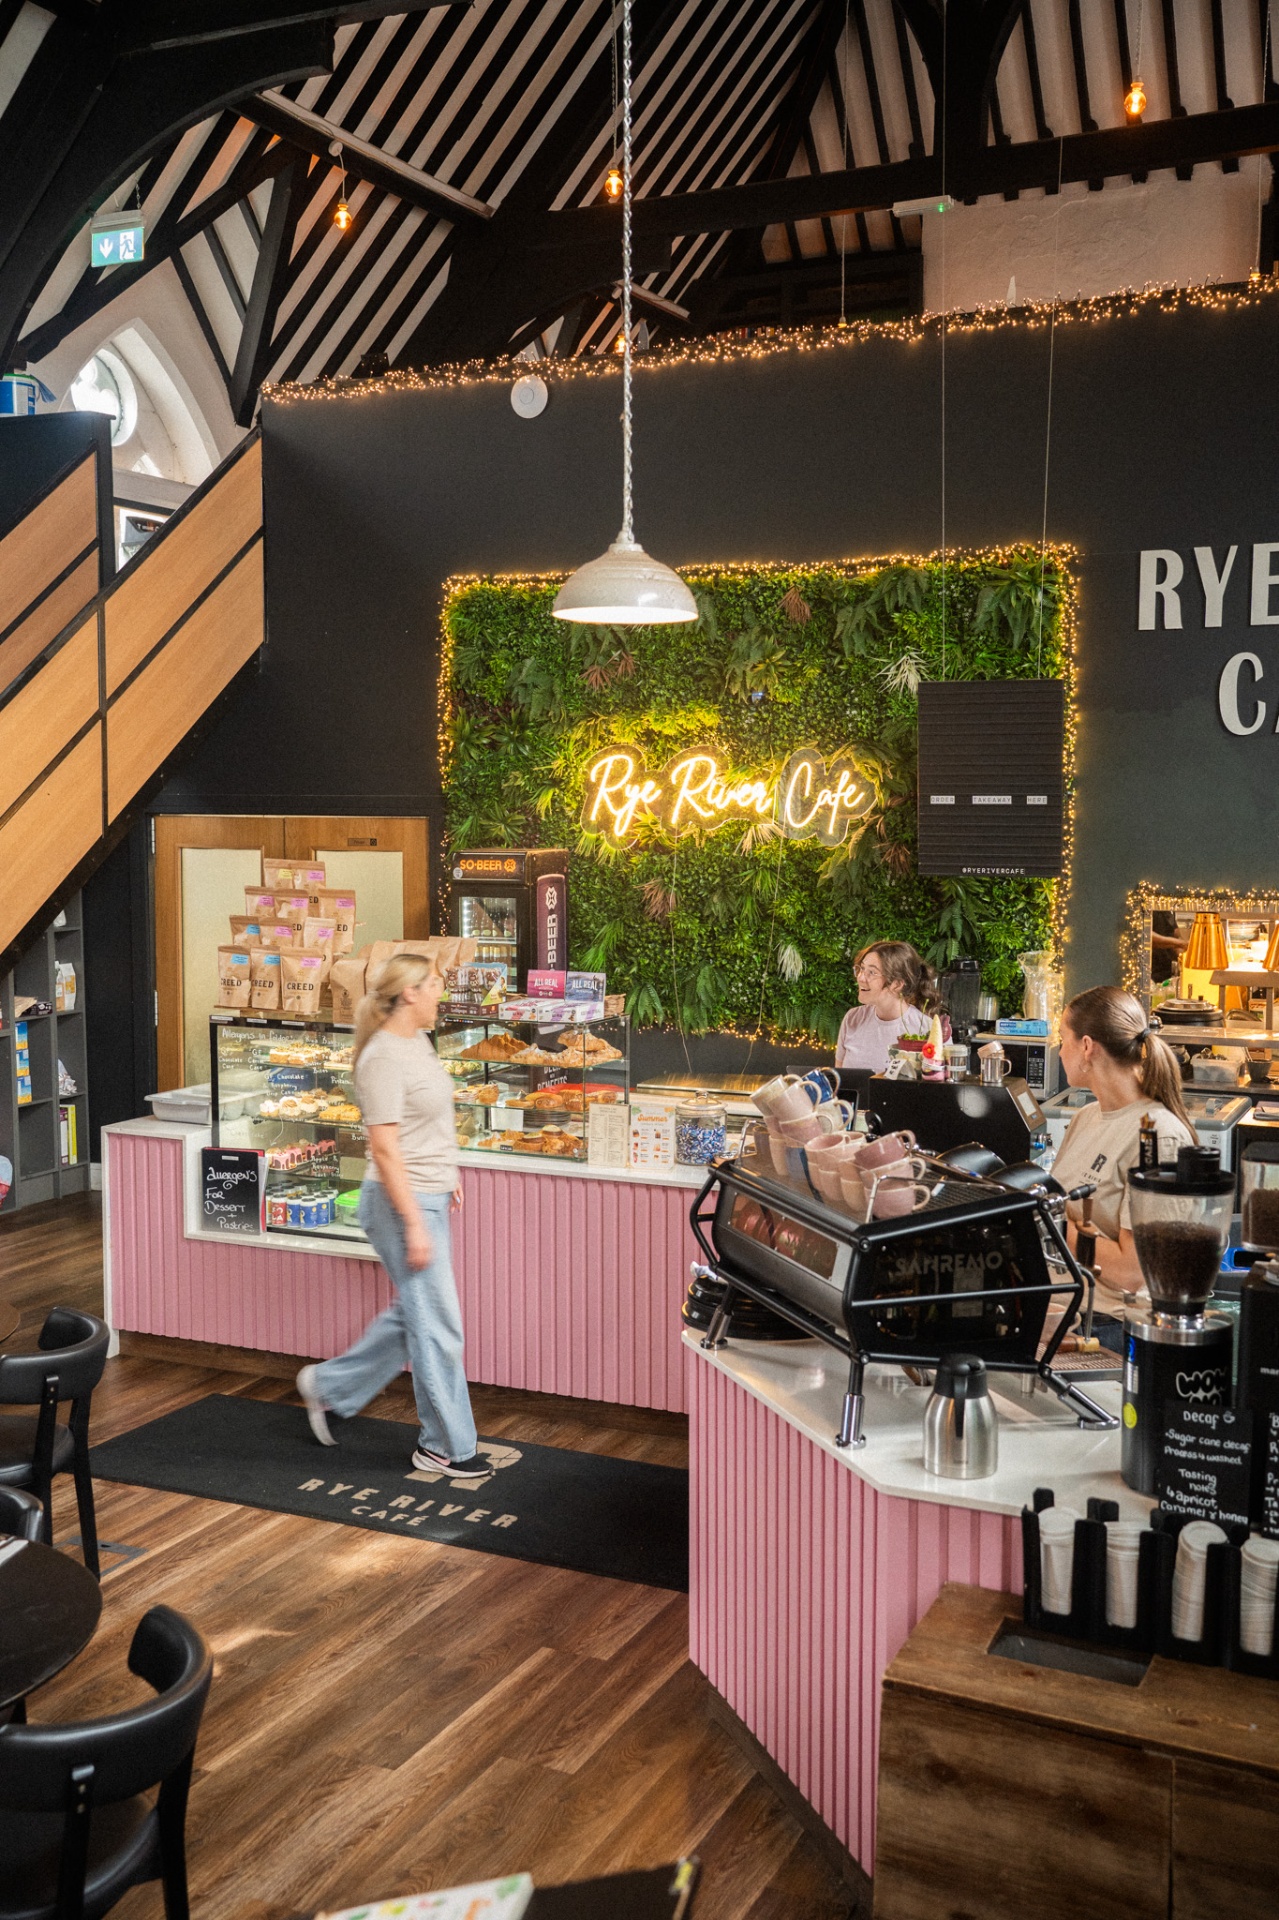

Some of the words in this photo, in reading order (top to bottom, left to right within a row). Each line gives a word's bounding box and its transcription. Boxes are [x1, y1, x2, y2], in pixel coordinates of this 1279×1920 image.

[1138, 542, 1279, 630] RYE
[1219, 652, 1279, 736] C
[590, 753, 662, 837] Rye
[670, 756, 773, 824] River
[784, 761, 864, 835] Cafe
[287, 982, 314, 991] CREED
[534, 978, 544, 987] ALL
[545, 978, 558, 988] REAL
[572, 980, 582, 989] ALL
[583, 981, 598, 990] REAL
[638, 1114, 668, 1122] Summer
[1090, 1153, 1107, 1173] R
[895, 1251, 1004, 1276] SANREMO
[1183, 1410, 1219, 1429] Decaf
[1199, 1436, 1221, 1447] cane
[1223, 1439, 1251, 1454] decaf
[1178, 1468, 1217, 1487] Tasting
[297, 1478, 380, 1501] RYE
[388, 1494, 519, 1528] RIVER
[1219, 1510, 1248, 1525] honey
